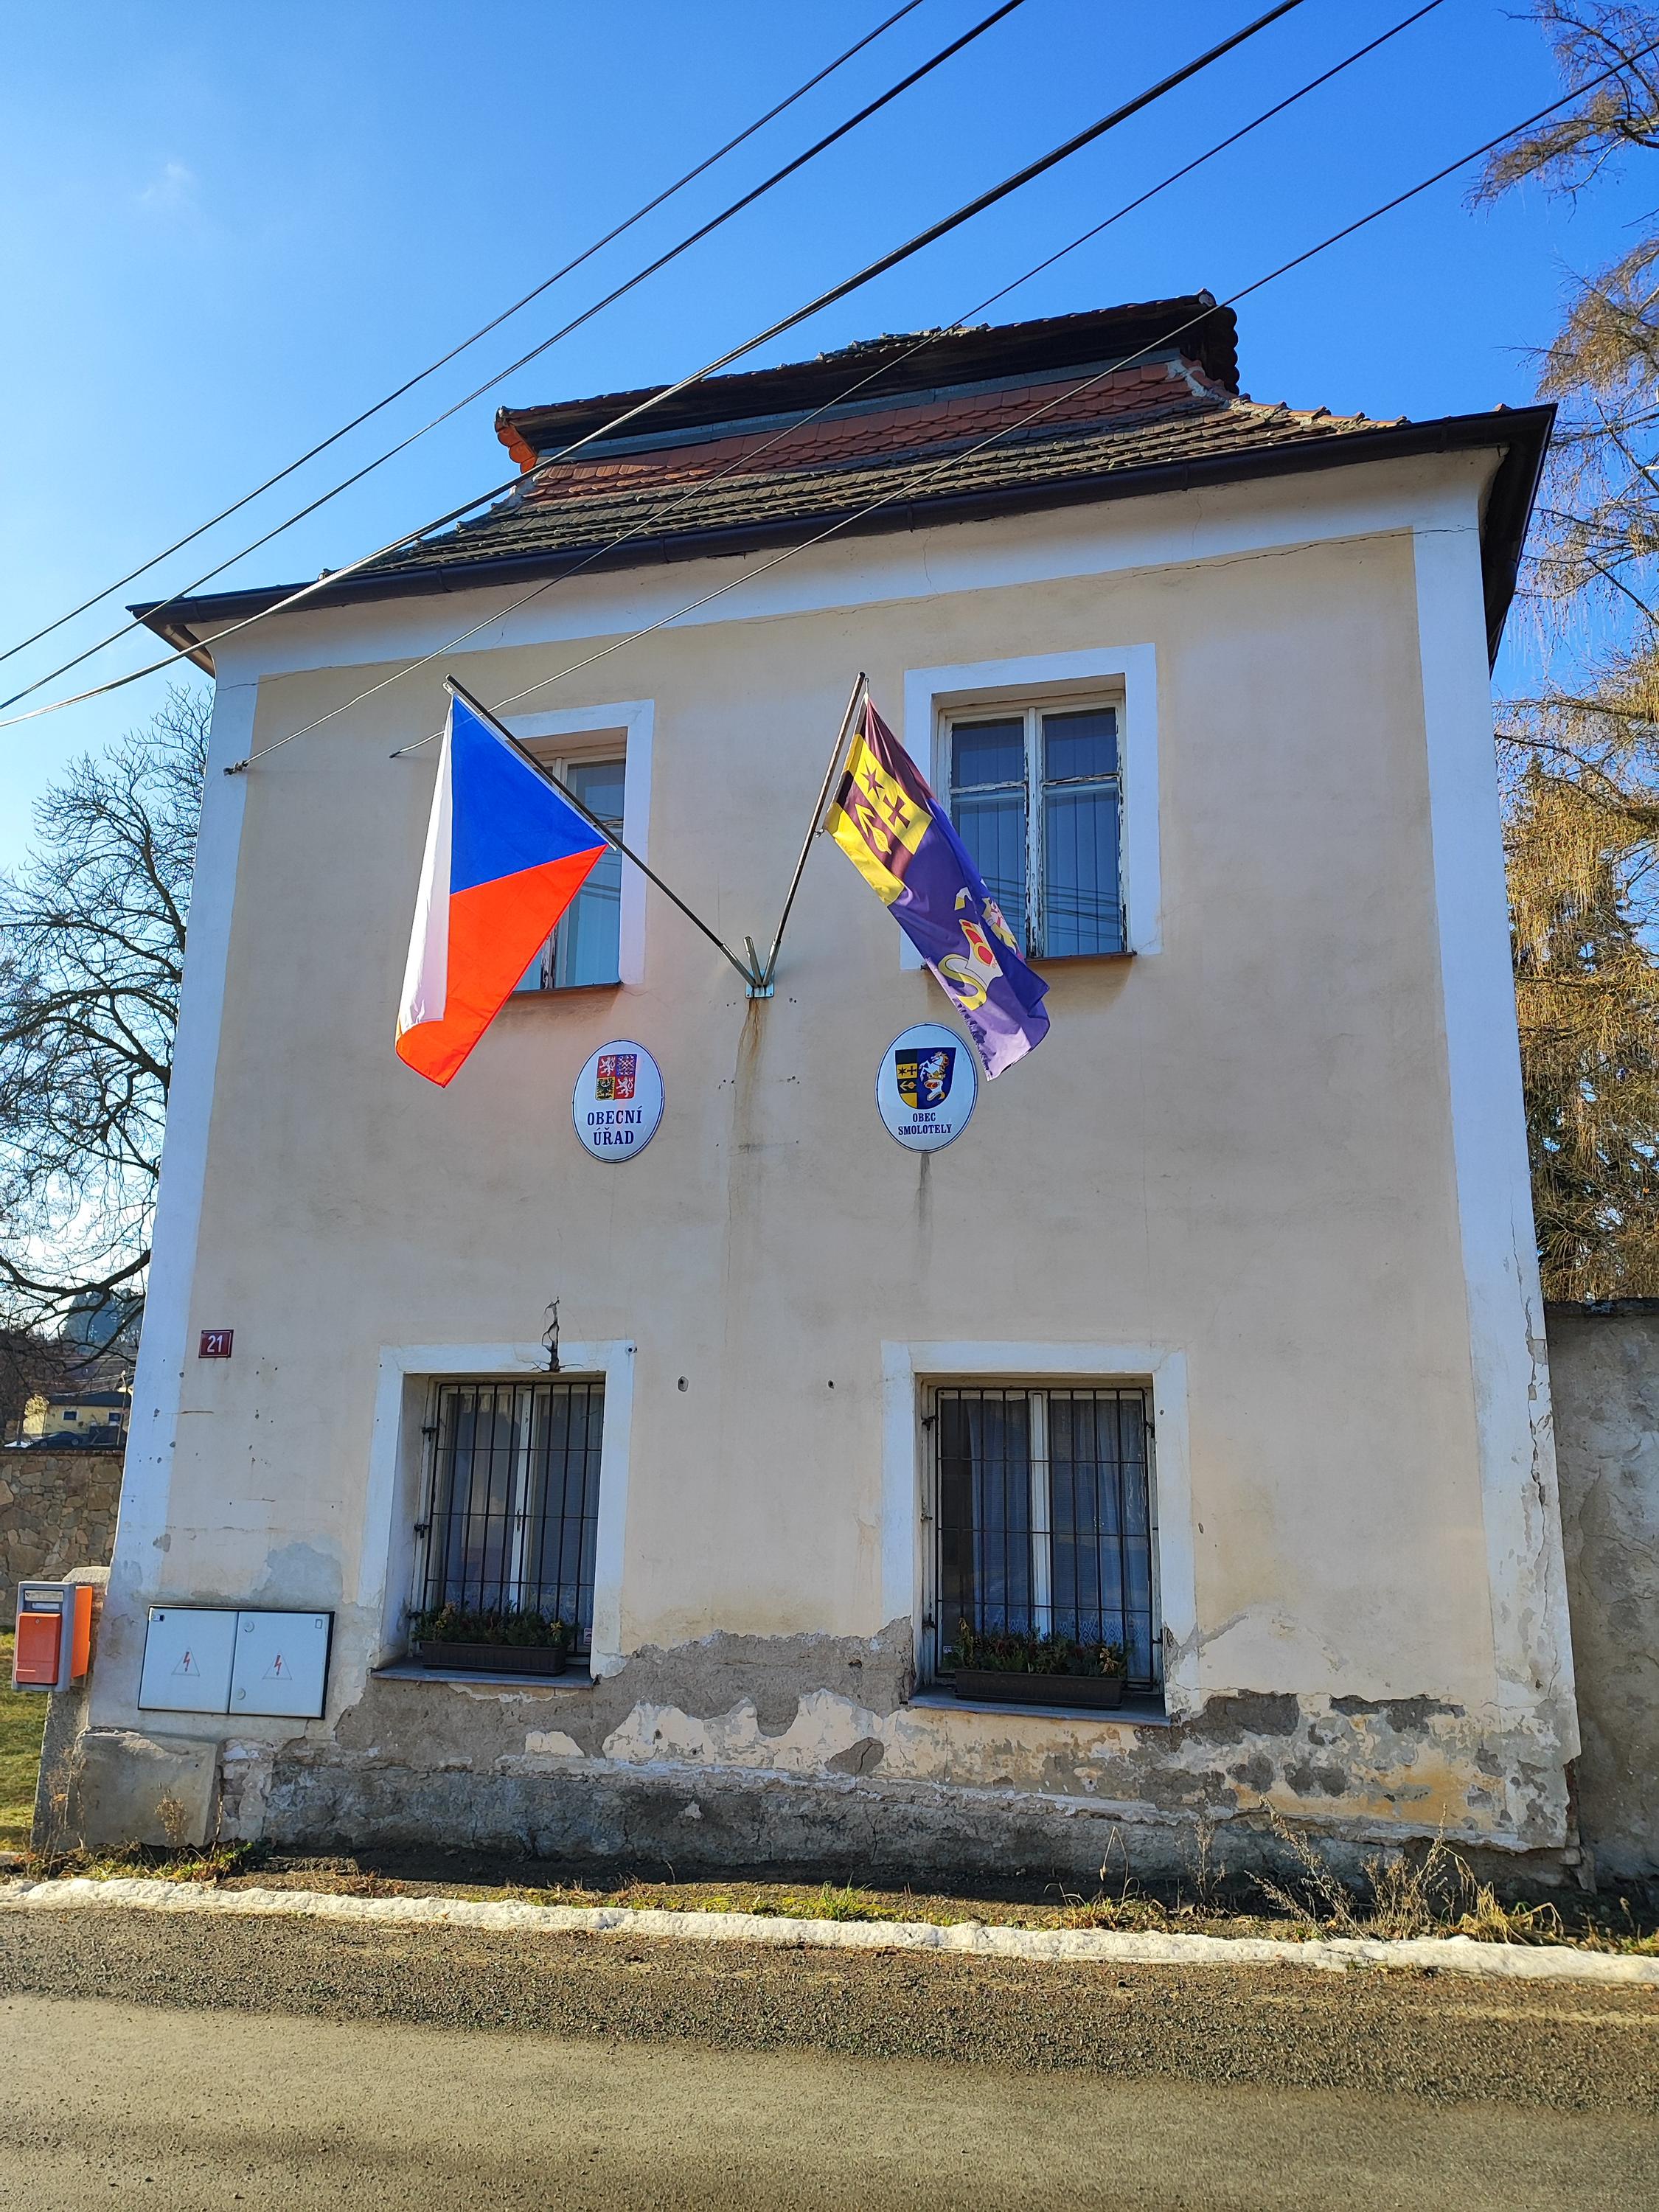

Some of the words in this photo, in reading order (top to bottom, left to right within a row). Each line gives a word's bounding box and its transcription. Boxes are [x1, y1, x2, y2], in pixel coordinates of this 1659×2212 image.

[587, 1105, 642, 1126] OBECNÍ
[912, 1112, 936, 1122] OBEC
[593, 1127, 634, 1146] ÚŘAD
[898, 1124, 952, 1135] SMOLOTELY
[206, 1335, 223, 1353] 21
